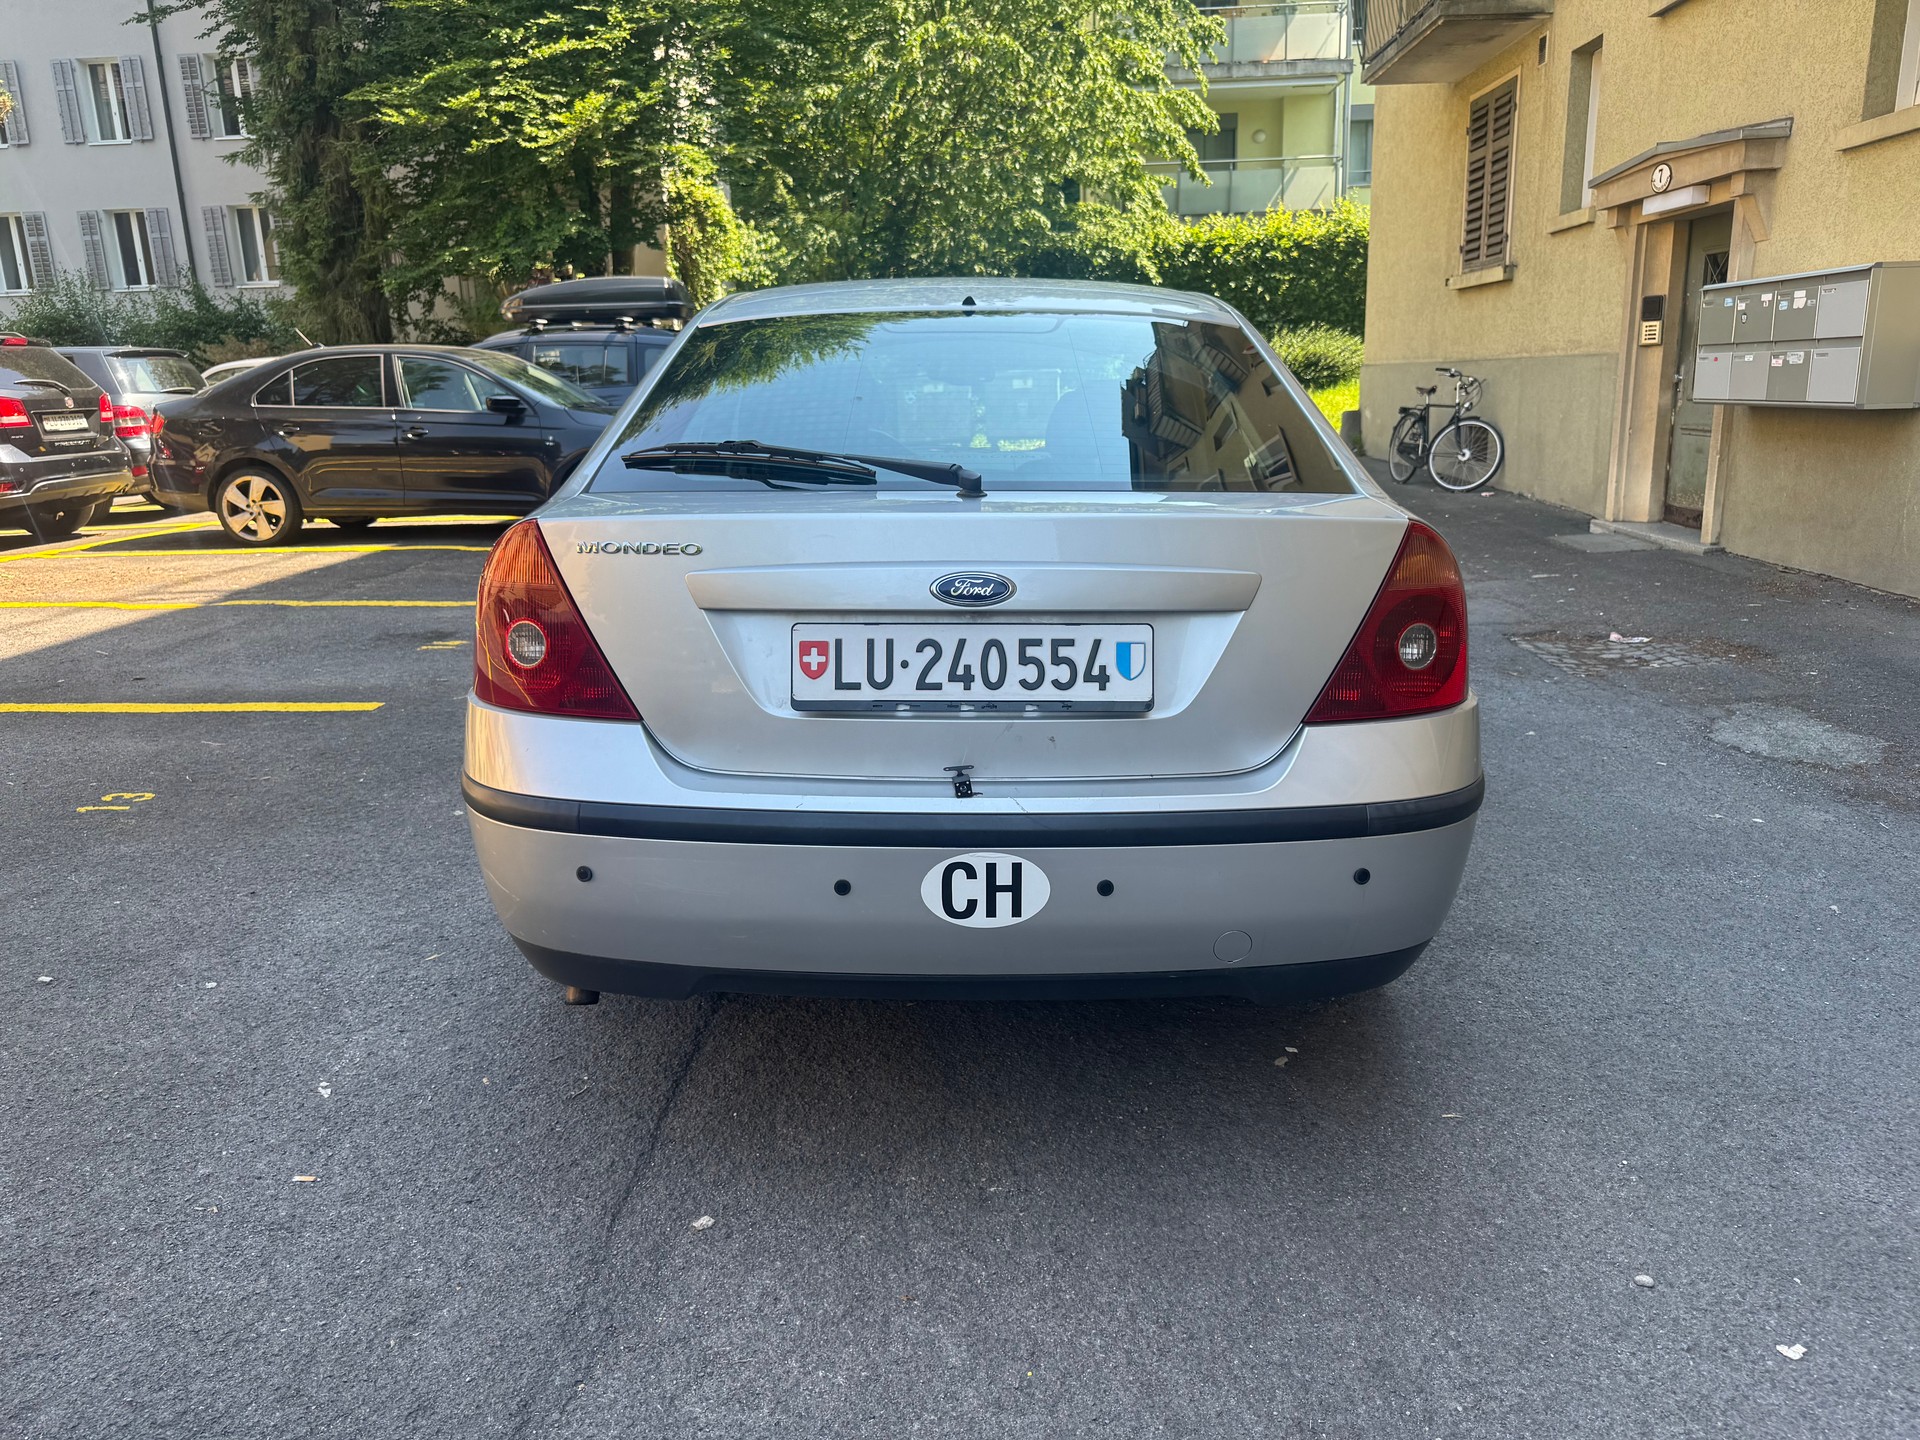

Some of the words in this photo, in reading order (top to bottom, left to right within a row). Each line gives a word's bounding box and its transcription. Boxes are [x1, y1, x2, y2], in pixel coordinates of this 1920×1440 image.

[576, 541, 703, 556] MONDEO
[950, 578, 995, 596] Ford
[941, 861, 1023, 920] CH
